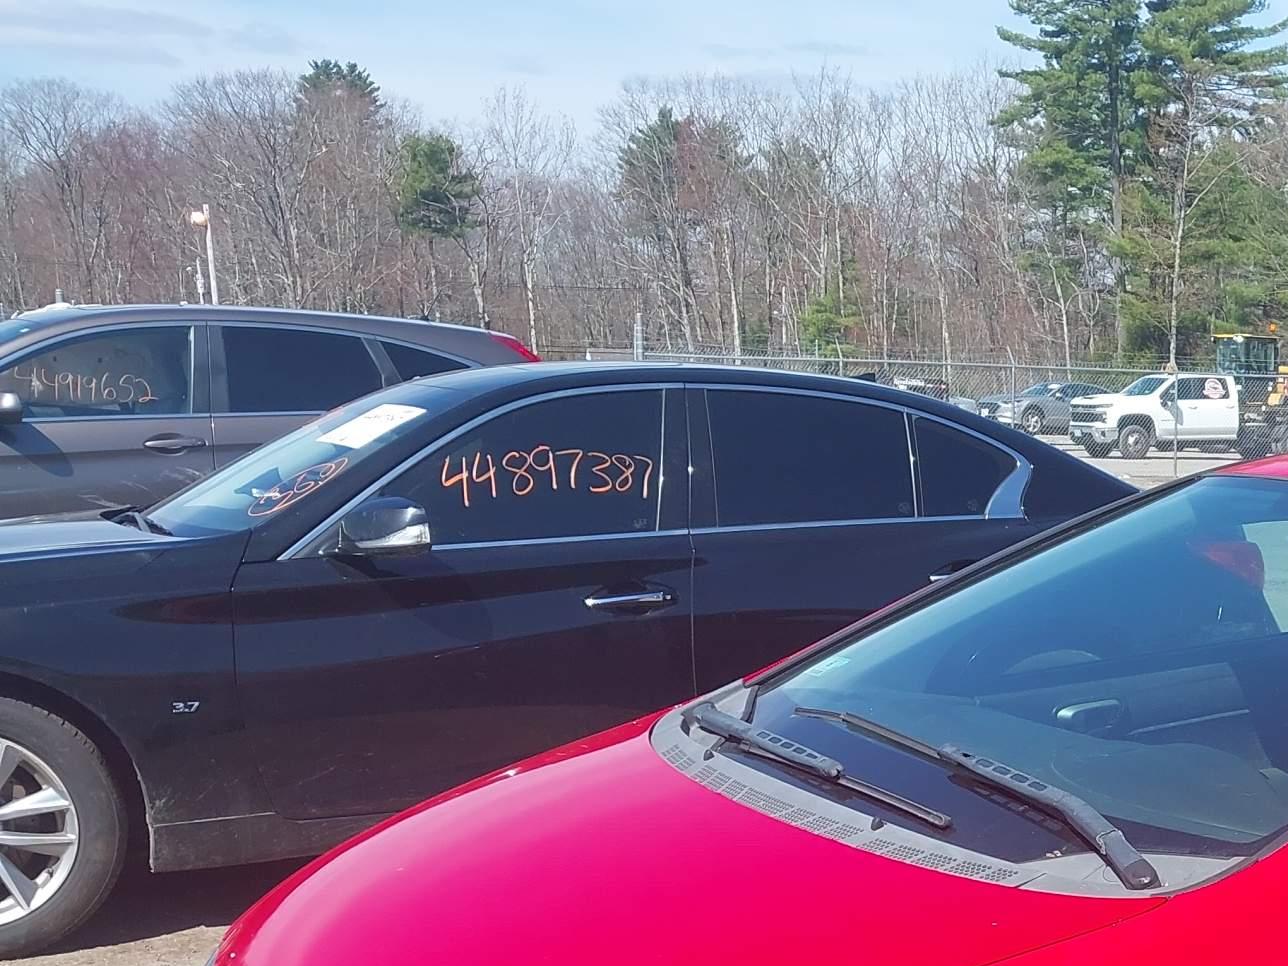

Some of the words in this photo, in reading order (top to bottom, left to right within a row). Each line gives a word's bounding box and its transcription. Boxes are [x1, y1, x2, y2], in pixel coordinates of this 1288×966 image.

[14, 366, 159, 402] 44919652
[441, 446, 654, 507] 44897387
[172, 701, 200, 713] 3.7
